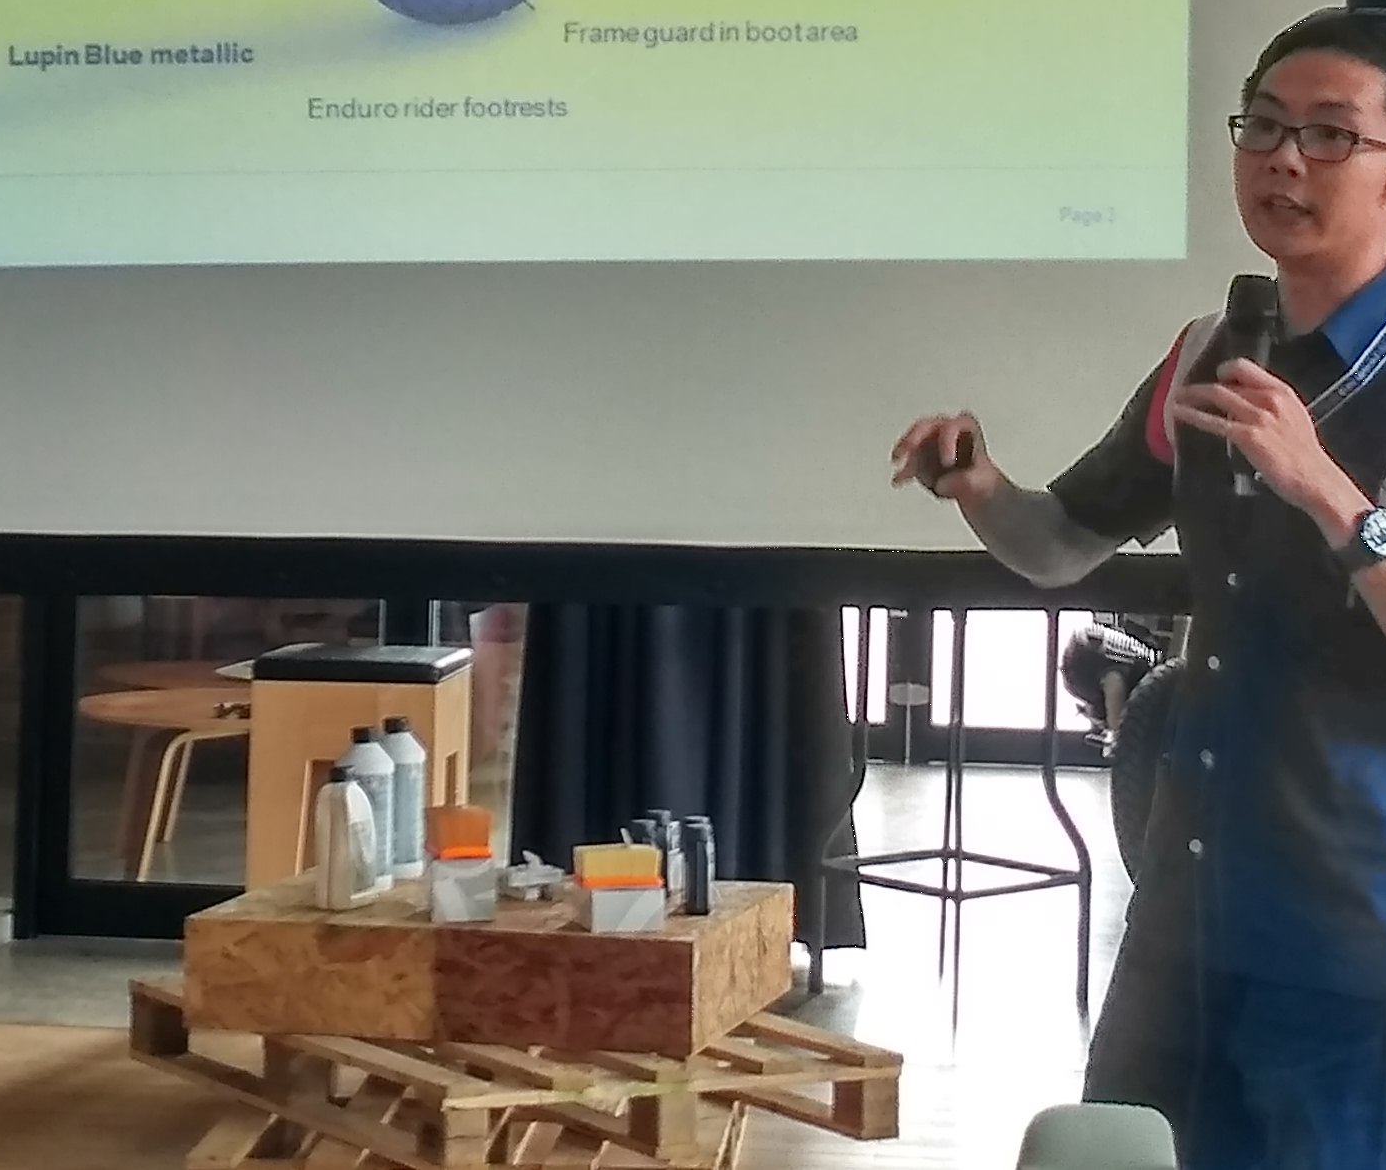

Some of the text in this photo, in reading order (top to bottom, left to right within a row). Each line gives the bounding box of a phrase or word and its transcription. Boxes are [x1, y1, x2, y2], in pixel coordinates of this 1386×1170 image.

[563, 20, 859, 49] Frame guard in boot area
[8, 43, 255, 71] Lupin Blue metallic
[308, 96, 569, 120] Enduro rider footrests
